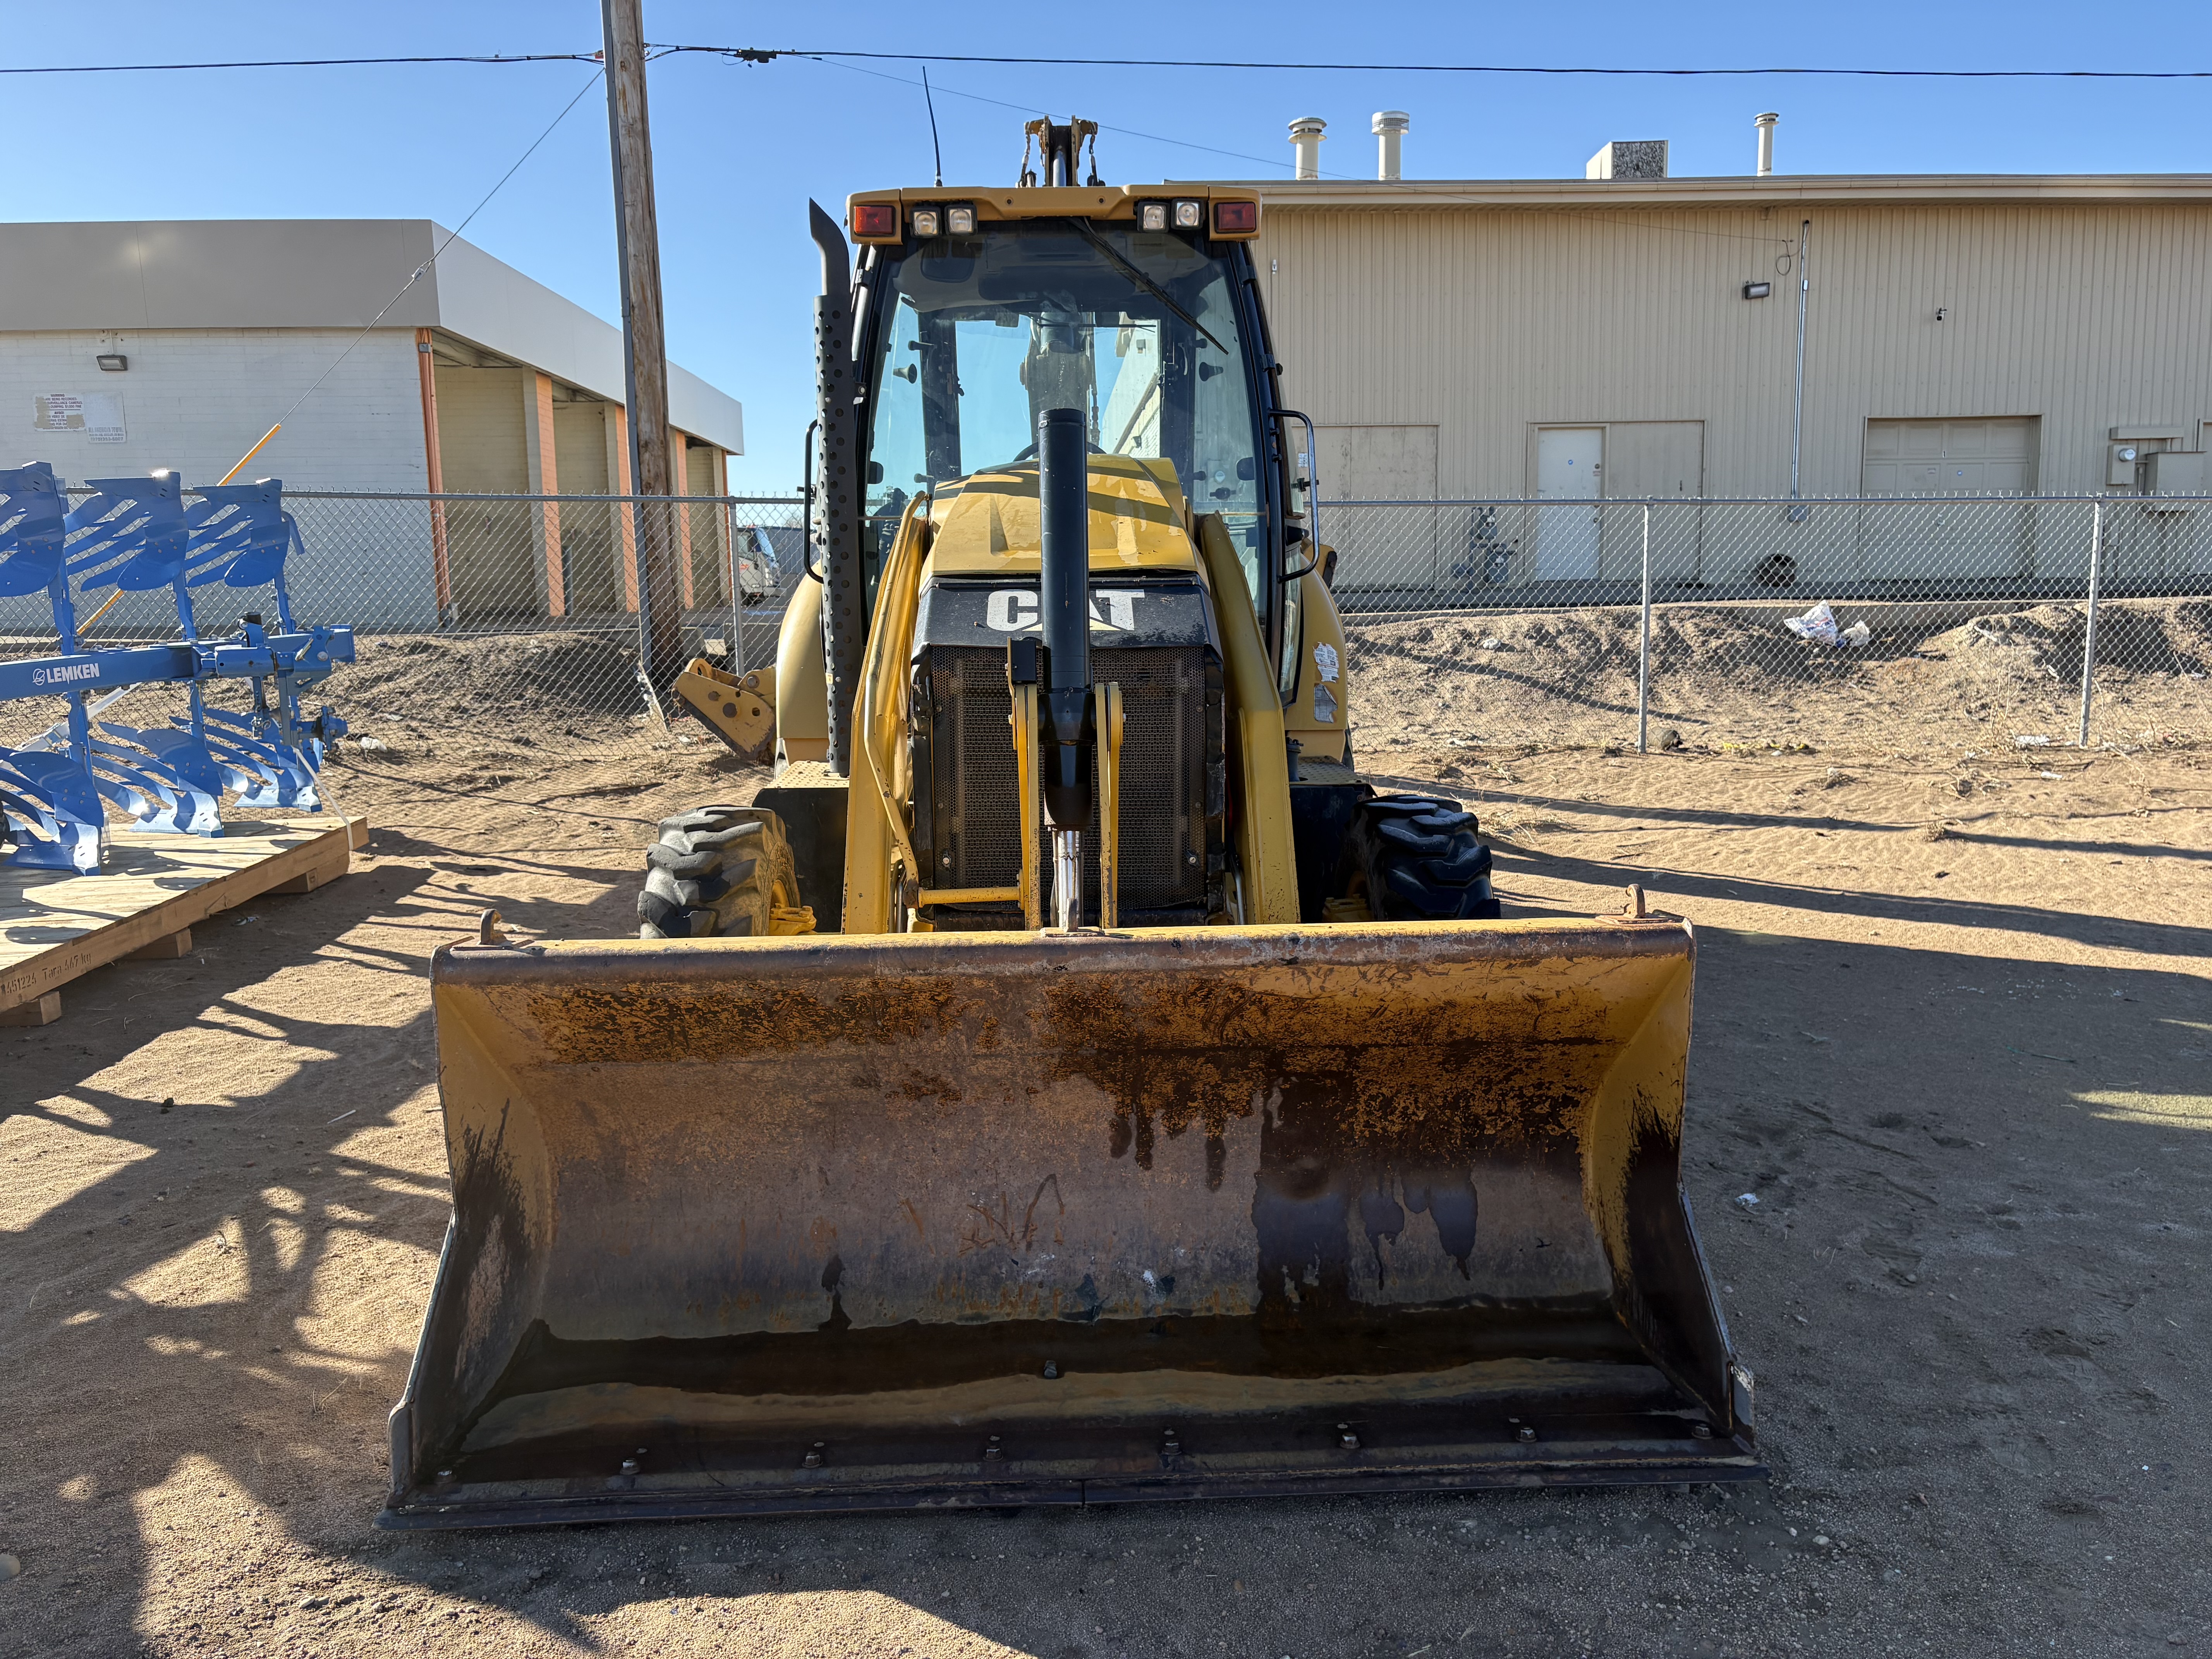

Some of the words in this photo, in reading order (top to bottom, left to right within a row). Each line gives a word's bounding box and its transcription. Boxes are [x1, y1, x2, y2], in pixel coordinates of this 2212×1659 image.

[987, 589, 1144, 631] CT
[46, 663, 100, 684] LEMKEN
[42, 965, 61, 980] Tara
[81, 953, 91, 965] kg
